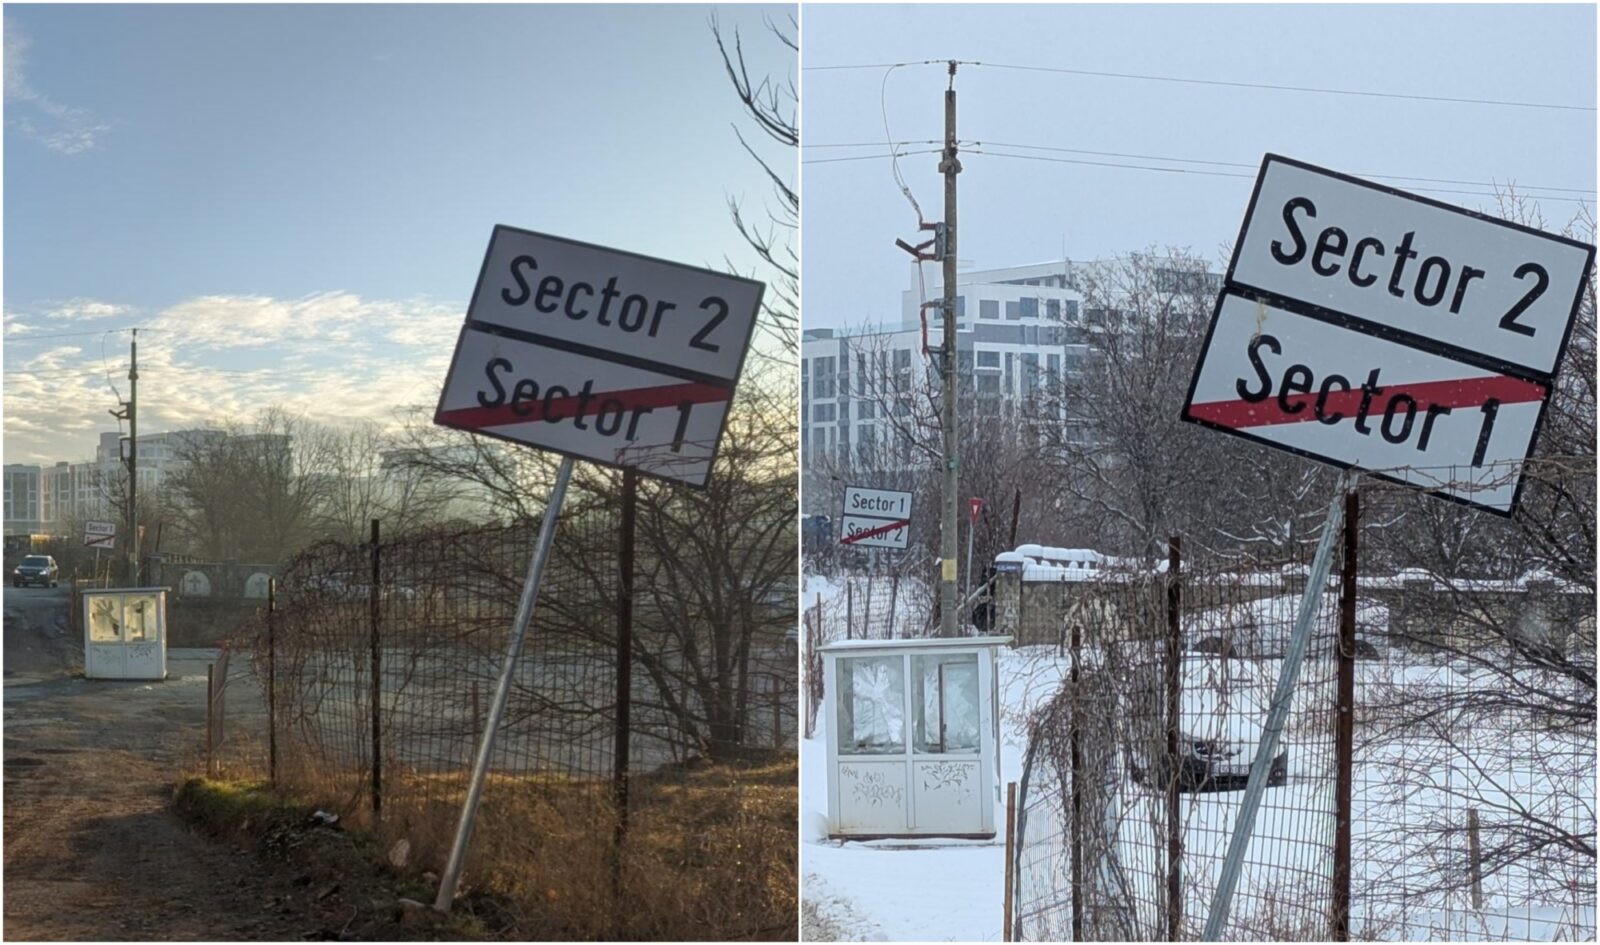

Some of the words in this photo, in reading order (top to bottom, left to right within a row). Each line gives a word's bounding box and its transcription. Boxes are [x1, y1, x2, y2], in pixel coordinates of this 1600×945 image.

[501, 255, 677, 337] Sector
[689, 296, 729, 353] 2
[1270, 196, 1485, 314] Sector
[1498, 262, 1550, 337] 2
[477, 357, 653, 441] Sector
[670, 401, 693, 453] 1
[1235, 334, 1452, 452] Sector
[1471, 397, 1500, 468] 1
[852, 493, 895, 511] Sector
[900, 497, 904, 512] 1
[894, 526, 903, 542] 2
